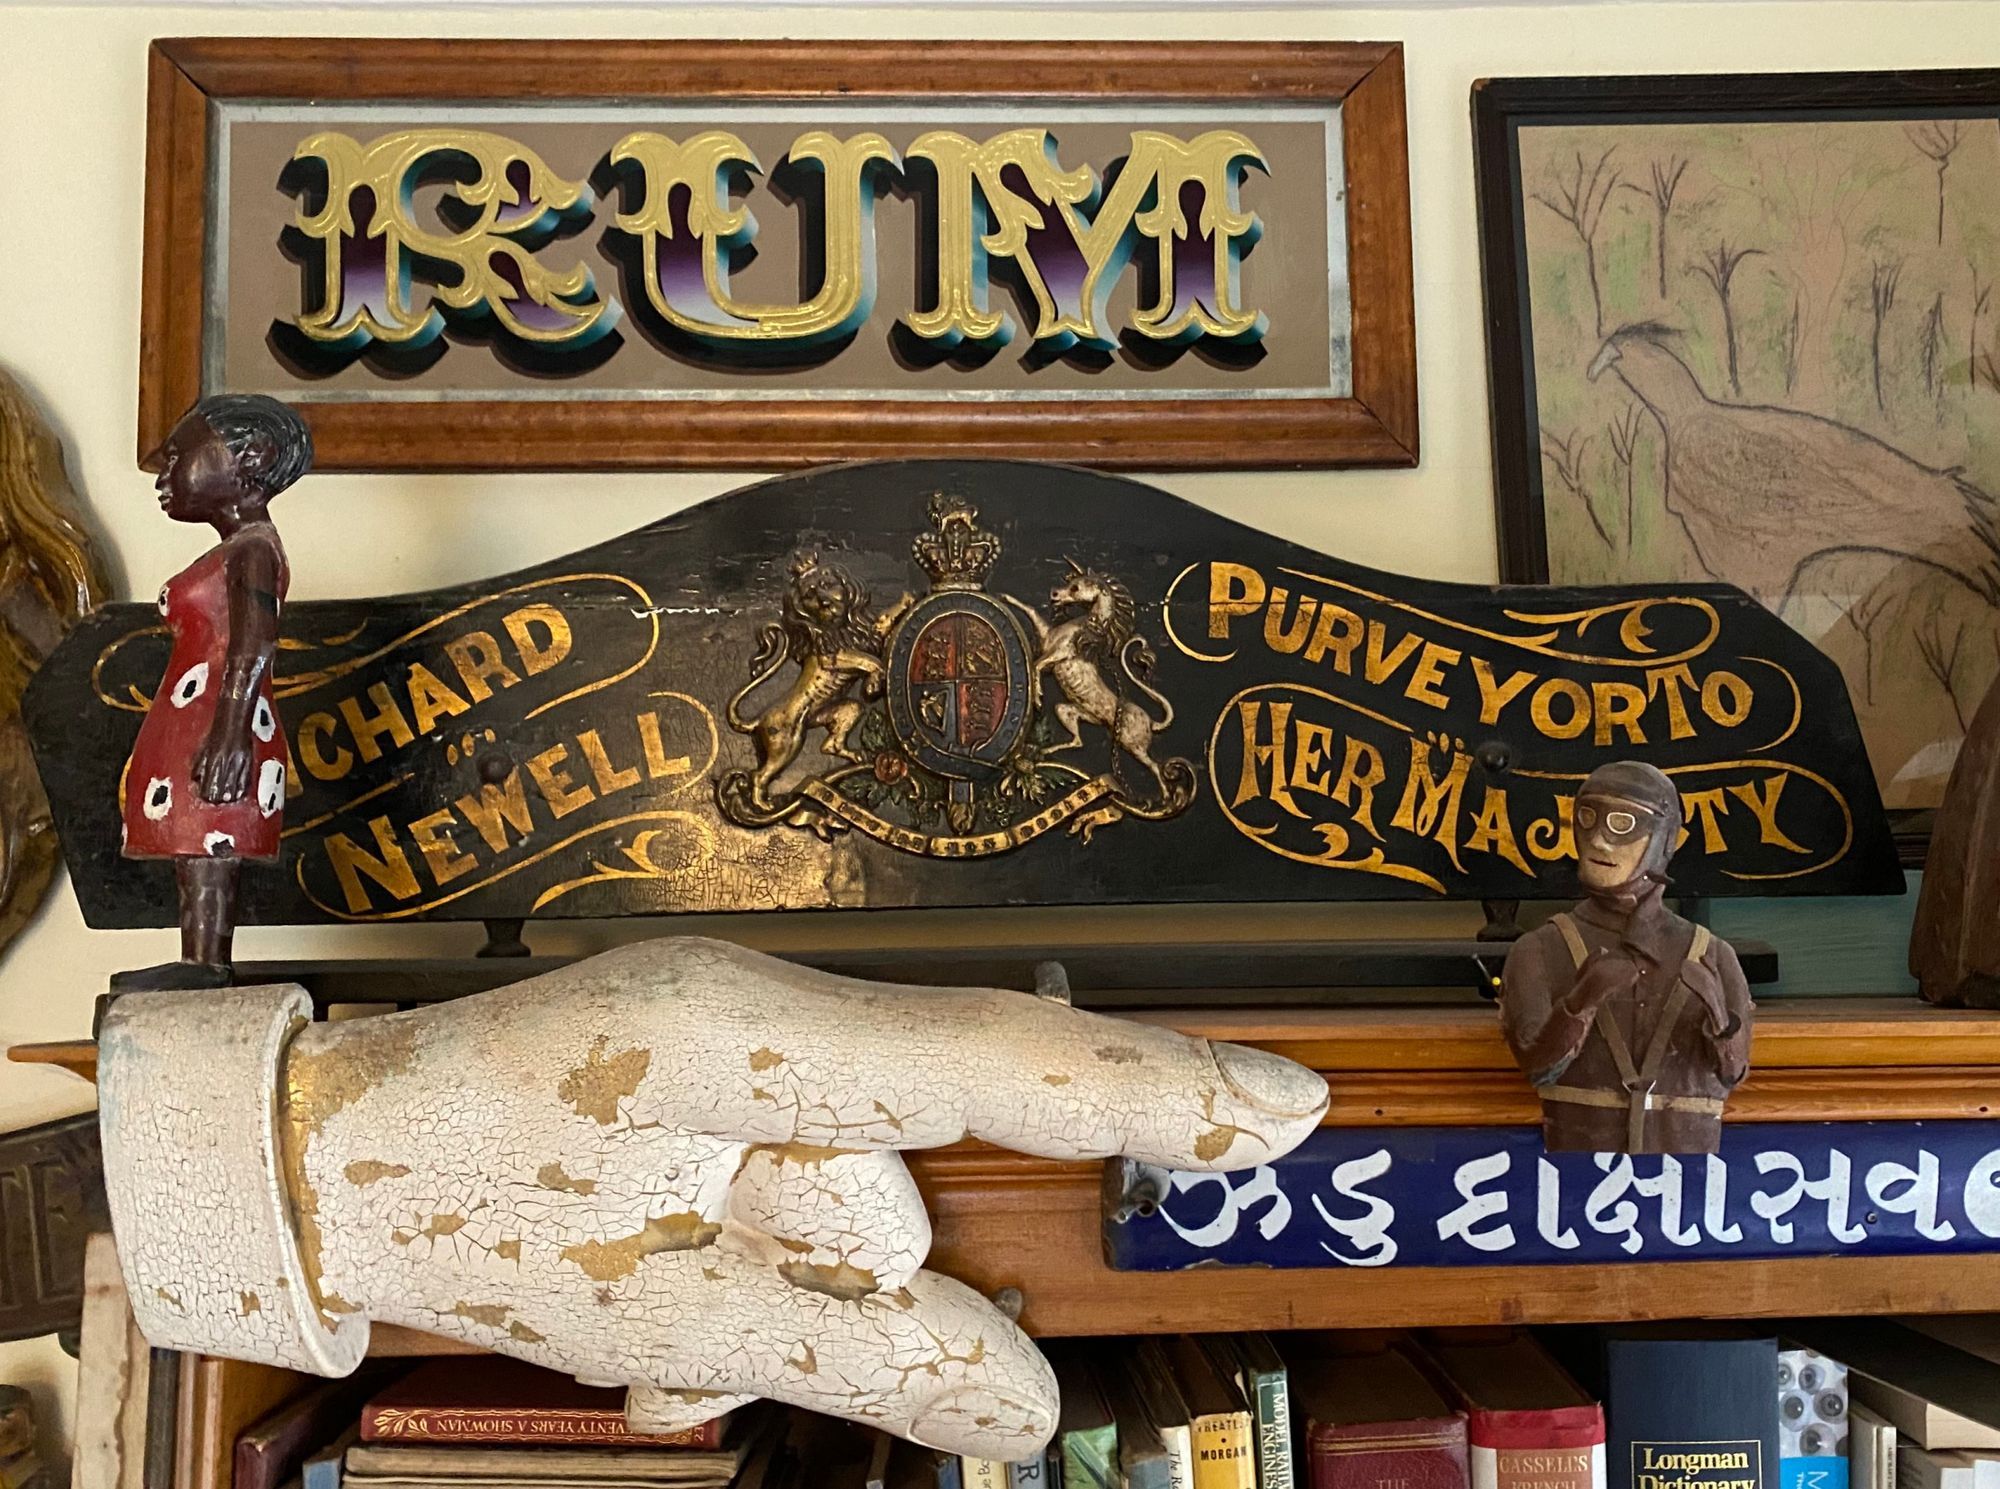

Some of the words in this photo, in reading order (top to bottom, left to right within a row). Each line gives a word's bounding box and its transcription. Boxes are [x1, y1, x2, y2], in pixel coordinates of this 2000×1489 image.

[290, 129, 1272, 347] RUM
[1207, 560, 1649, 747] PURVEYOR
[1646, 662, 1754, 741] TO
[286, 602, 573, 798] CHARD
[1231, 701, 1388, 843] HER
[323, 710, 692, 914] NEWELL
[1390, 735, 1814, 878] MAJTY
[435, 1419, 514, 1434] SHOWMAN
[518, 1420, 529, 1433] A
[530, 1420, 576, 1434] YEARS
[577, 1420, 632, 1434] VENTY
[1272, 1393, 1289, 1448] MODEL
[1200, 1446, 1247, 1460] MORGAN
[1262, 1423, 1278, 1489] ENGINES
[1500, 1455, 1589, 1474] CASSELL'S
[1643, 1447, 1749, 1475] Longman
[1637, 1474, 1756, 1489] Dictionary
